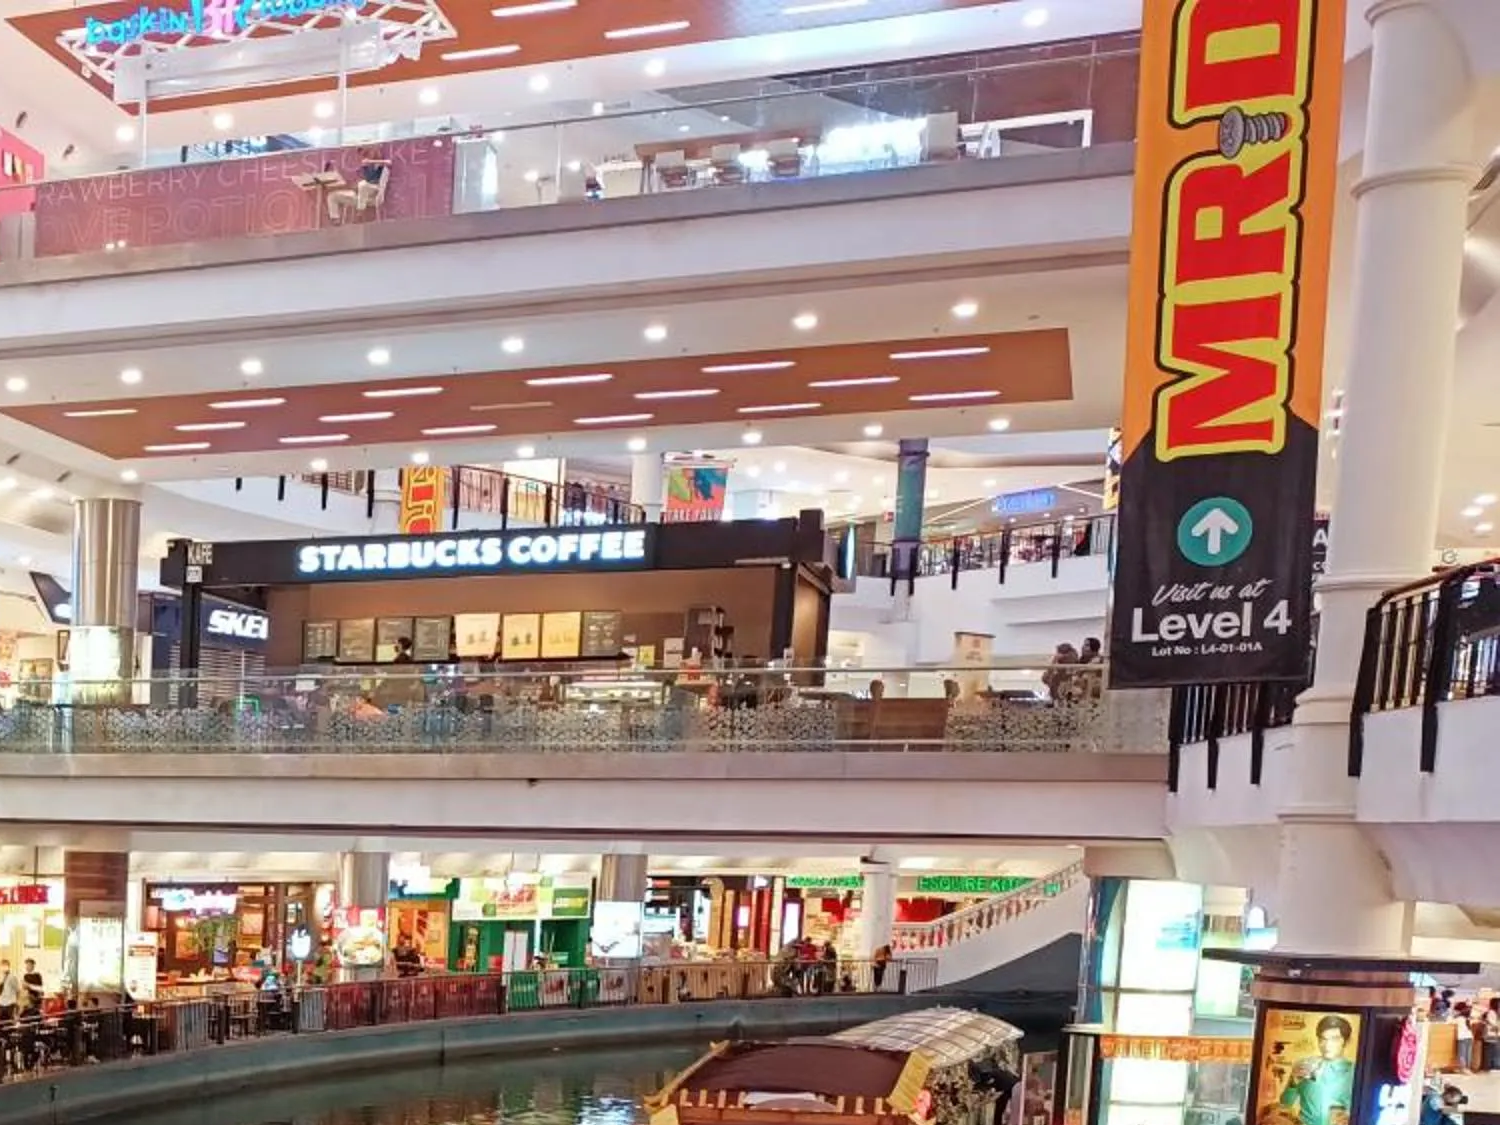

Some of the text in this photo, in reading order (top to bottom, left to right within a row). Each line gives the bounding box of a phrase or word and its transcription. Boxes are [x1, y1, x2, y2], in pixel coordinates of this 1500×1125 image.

[298, 530, 647, 574] STARBUCKS COFFEE
[1152, 577, 1274, 607] Visit us at
[1131, 599, 1293, 643] Level 4
[1151, 644, 1172, 657] Lot
